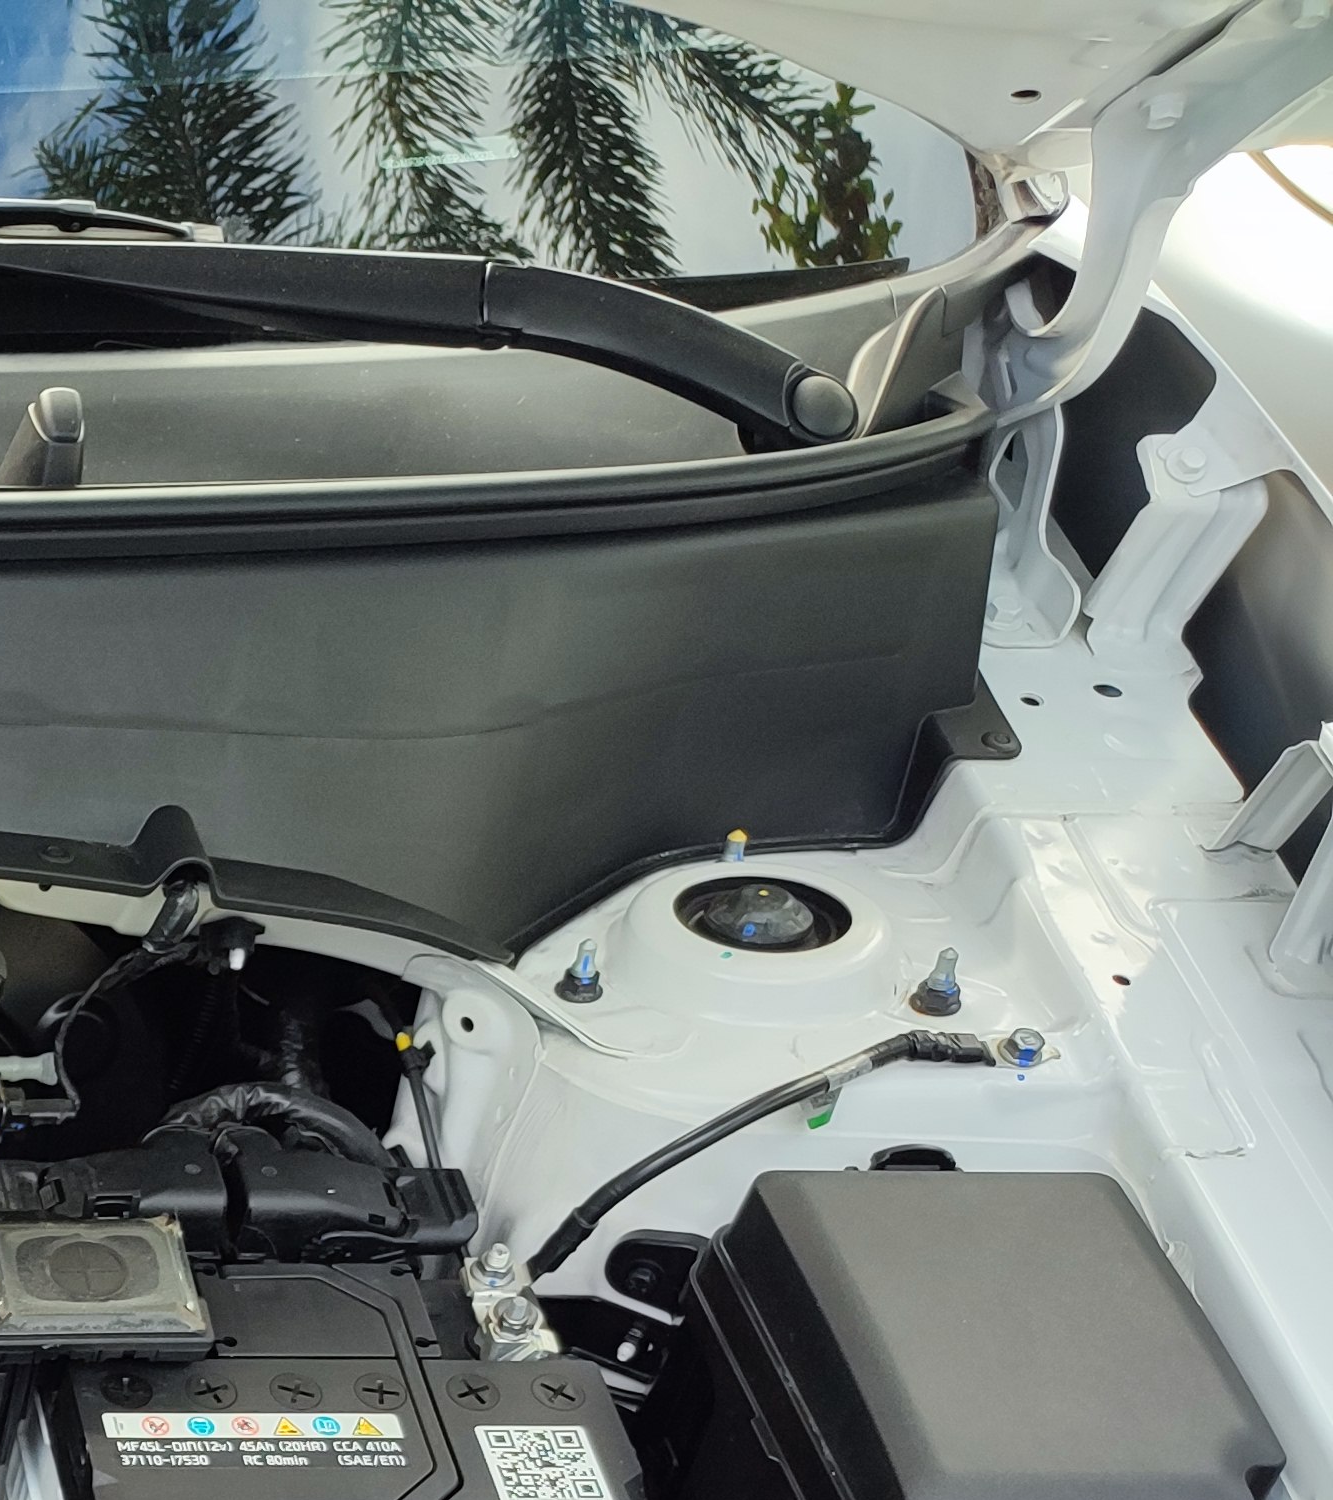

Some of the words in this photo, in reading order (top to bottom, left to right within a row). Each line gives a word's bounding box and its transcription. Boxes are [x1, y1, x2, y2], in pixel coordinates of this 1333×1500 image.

[239, 1441, 275, 1452] 45Ah
[279, 1441, 327, 1453] (20HR)
[333, 1441, 363, 1452] CCA
[366, 1441, 402, 1452] 410A
[243, 1455, 263, 1466] RC
[266, 1455, 308, 1466] 80min
